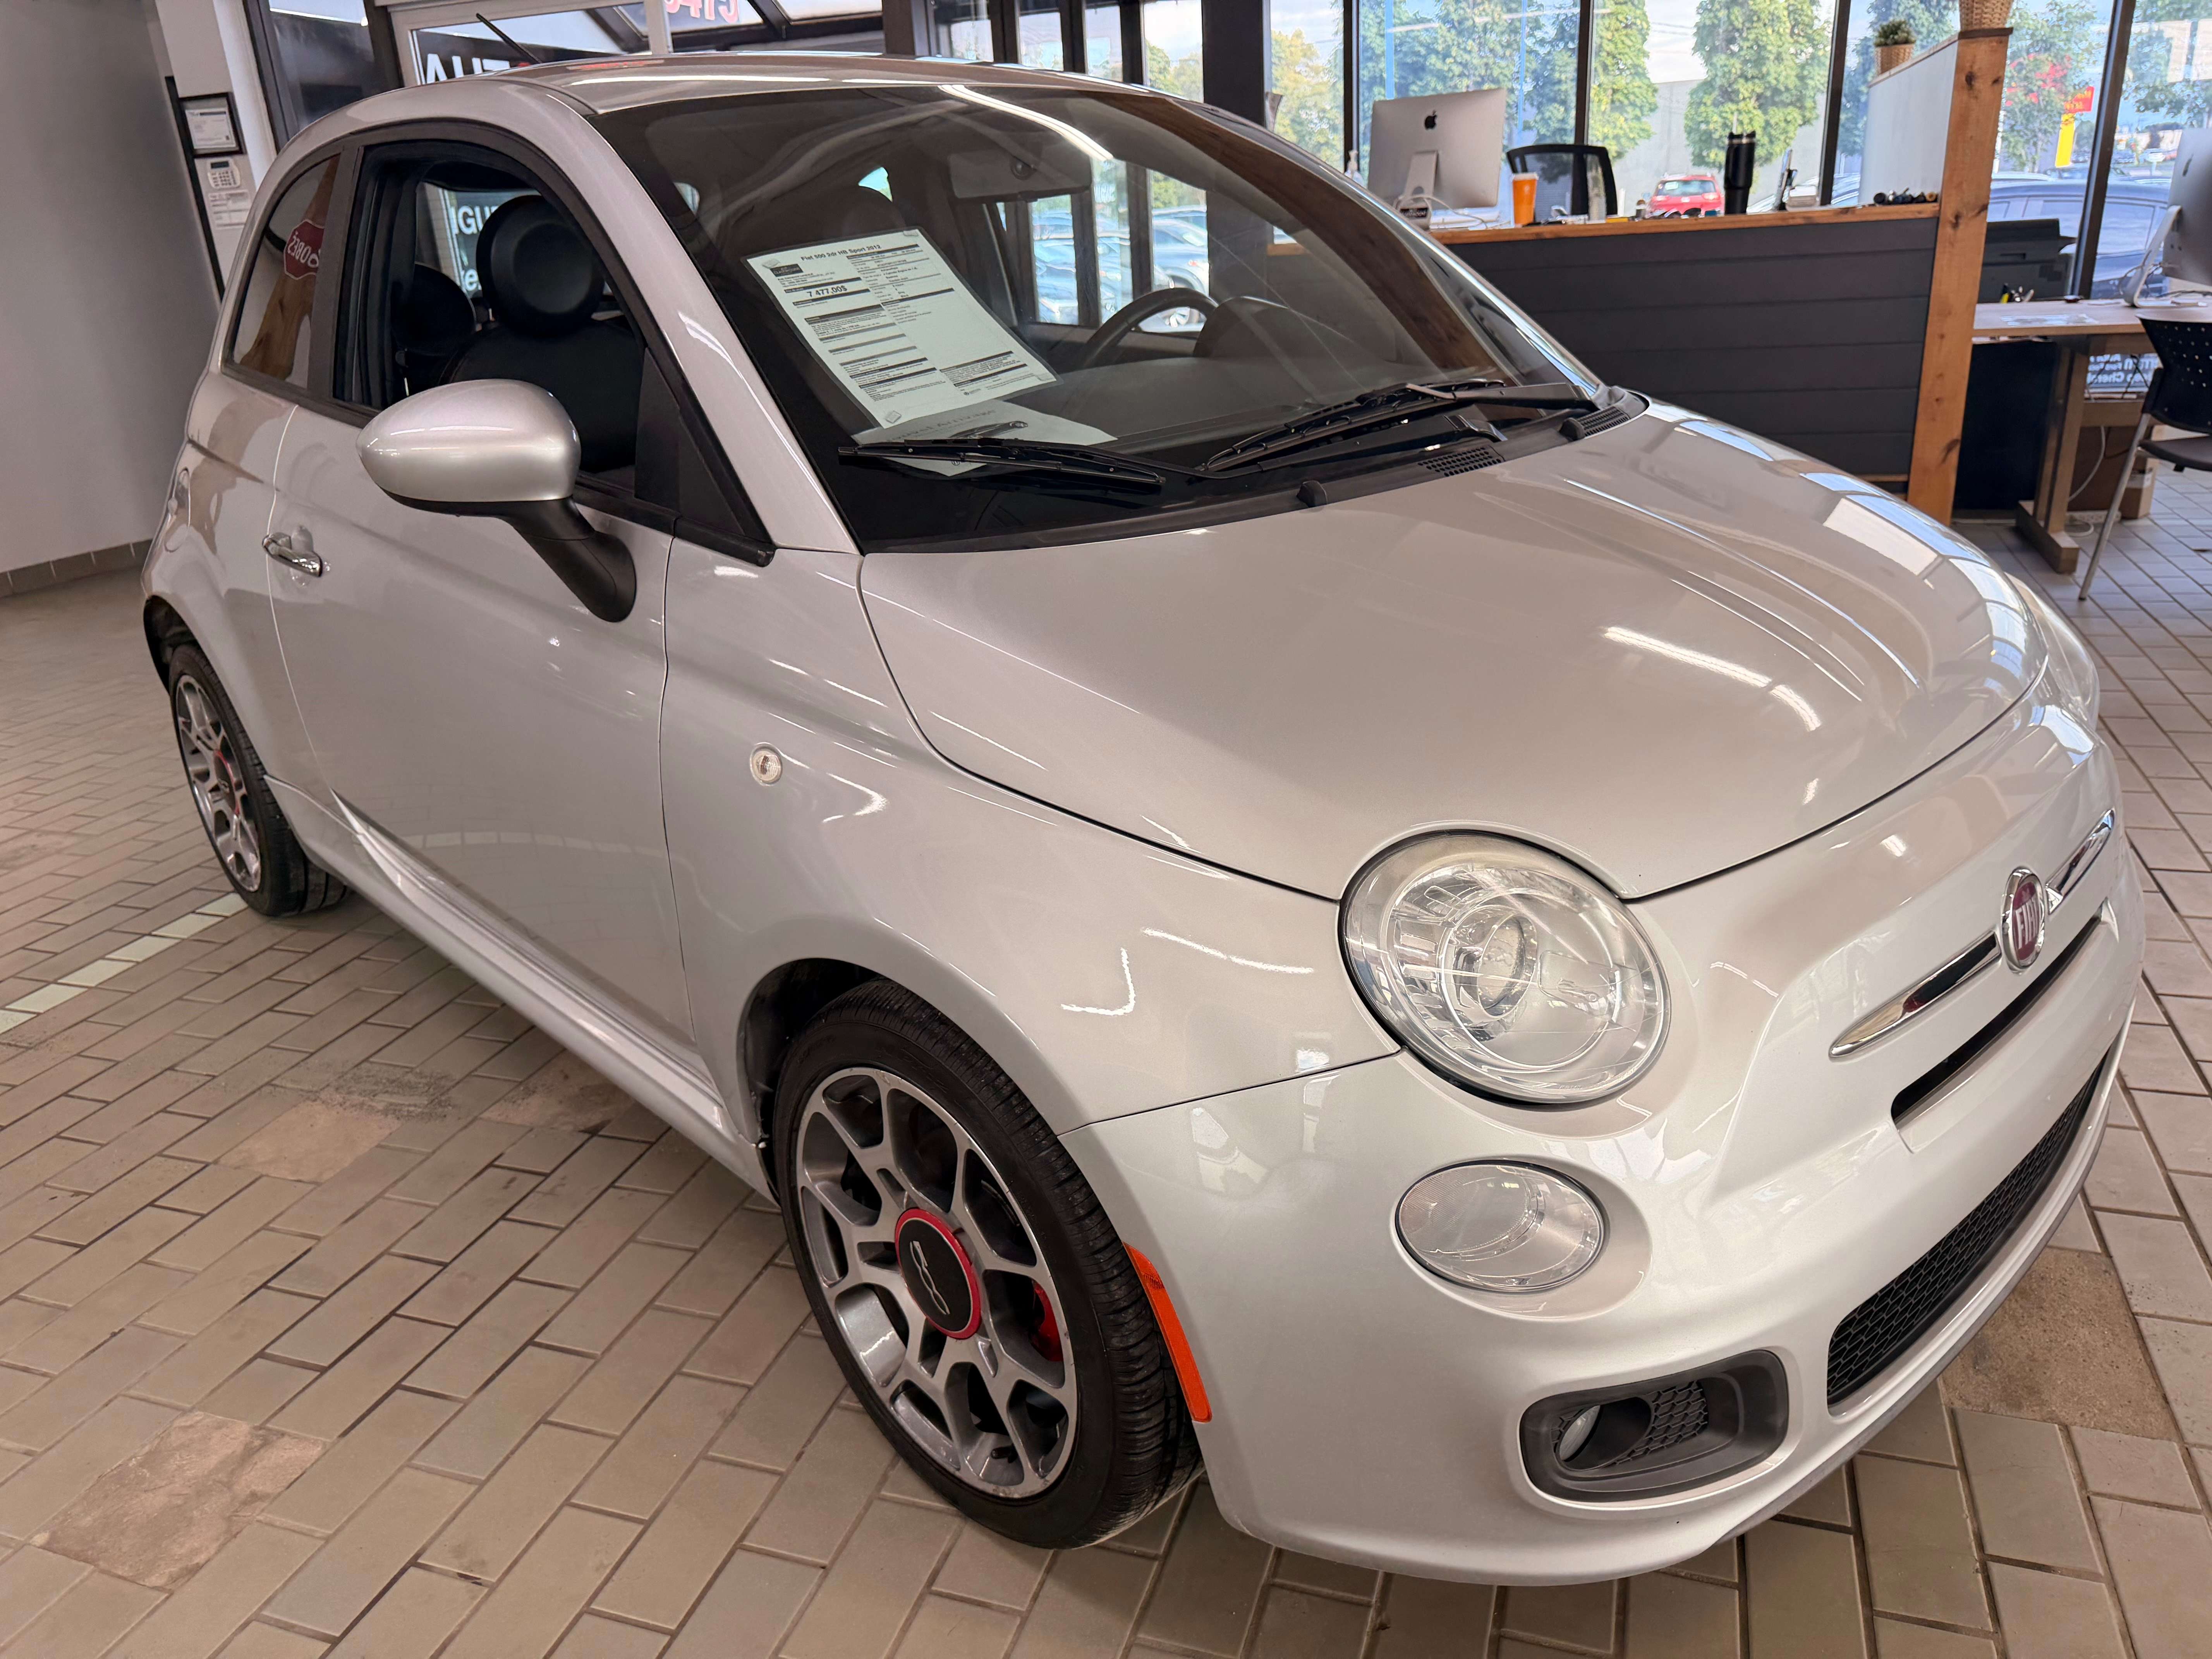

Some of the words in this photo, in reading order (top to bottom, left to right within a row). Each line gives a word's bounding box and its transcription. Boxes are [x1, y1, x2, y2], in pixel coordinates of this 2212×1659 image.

[426, 53, 510, 84] AU
[816, 285, 847, 295] 477,00$
[2015, 896, 2040, 950] FIAT
